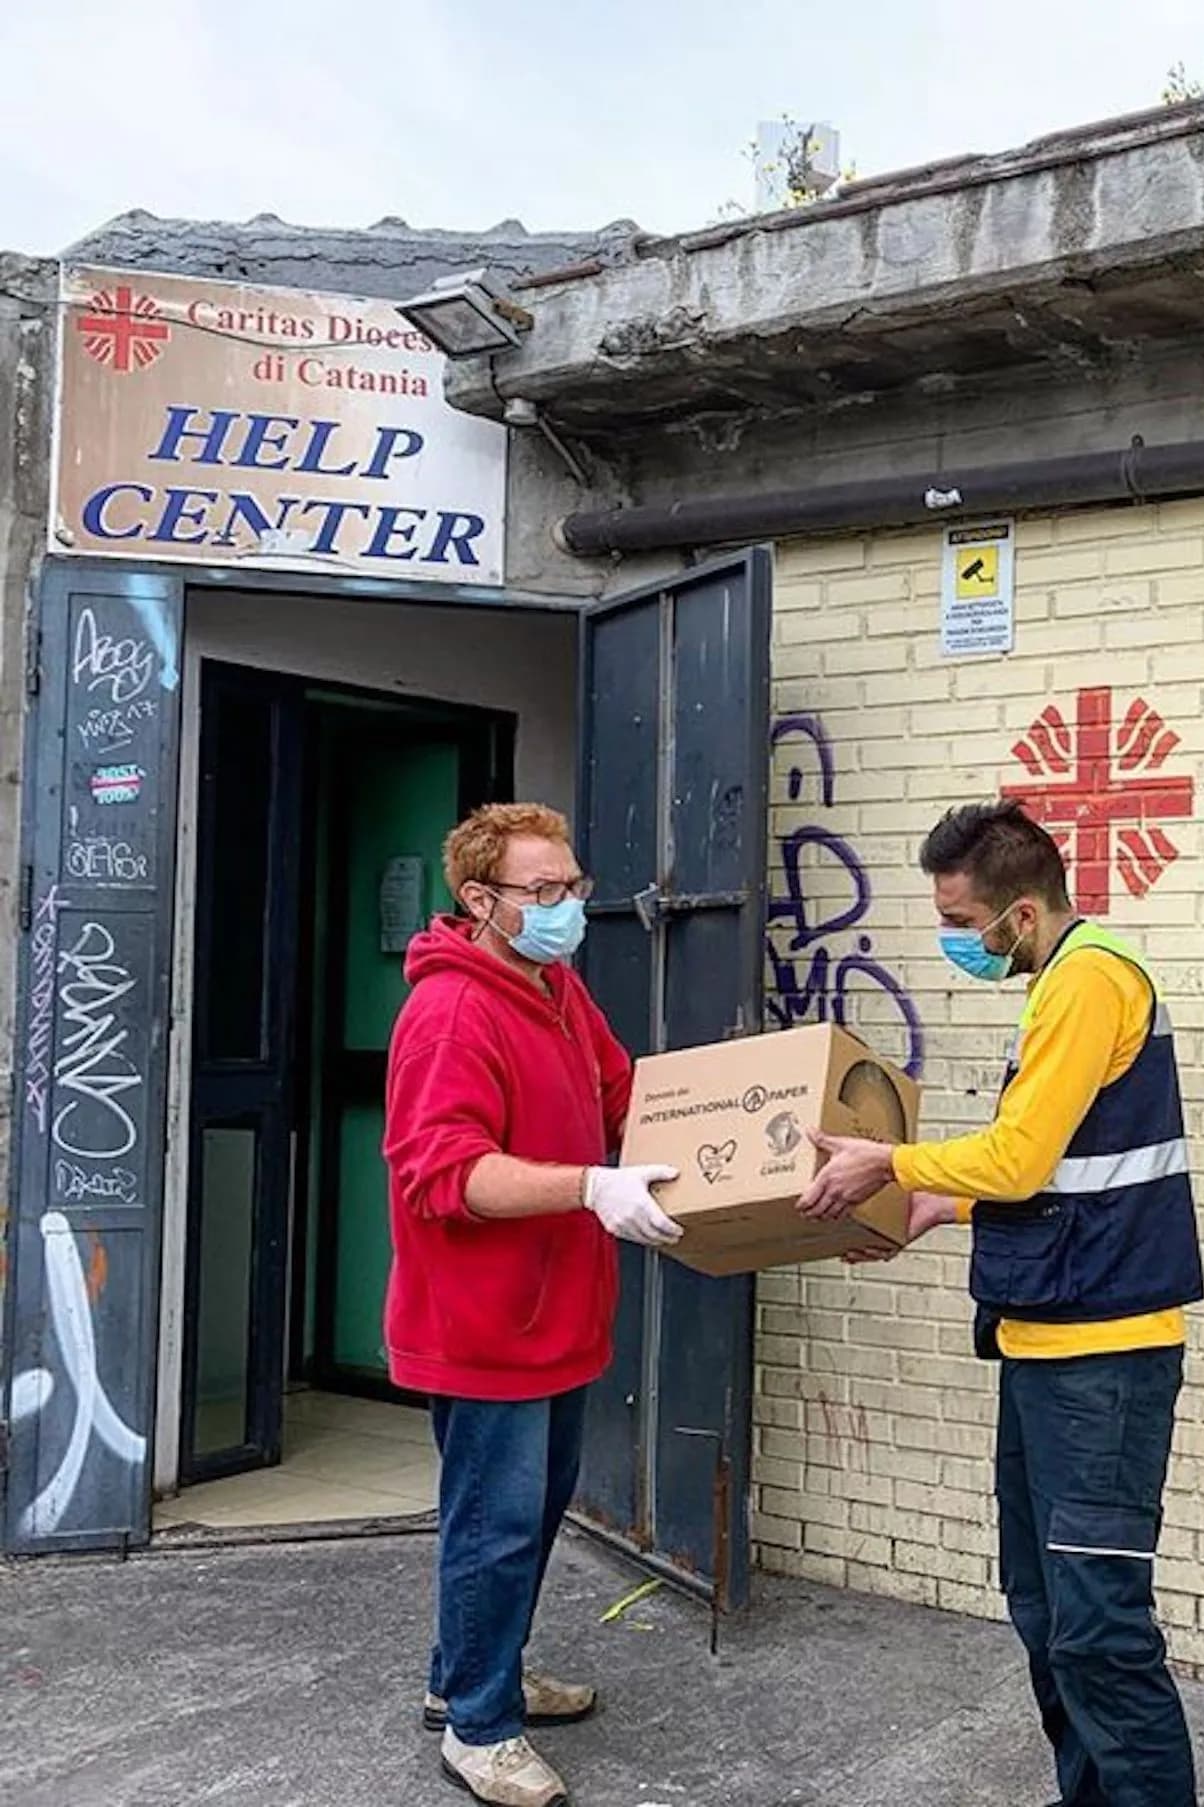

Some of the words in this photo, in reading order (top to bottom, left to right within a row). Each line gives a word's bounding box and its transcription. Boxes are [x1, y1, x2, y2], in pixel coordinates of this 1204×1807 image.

[188, 299, 315, 339] Caritas
[328, 315, 438, 352] Dioces
[253, 353, 285, 383] di
[298, 357, 429, 397] Catania
[148, 406, 425, 480] HELP
[81, 482, 487, 567] CENTER
[640, 1098, 741, 1125] INTERNATIONAL
[767, 1084, 809, 1101] PAPER
